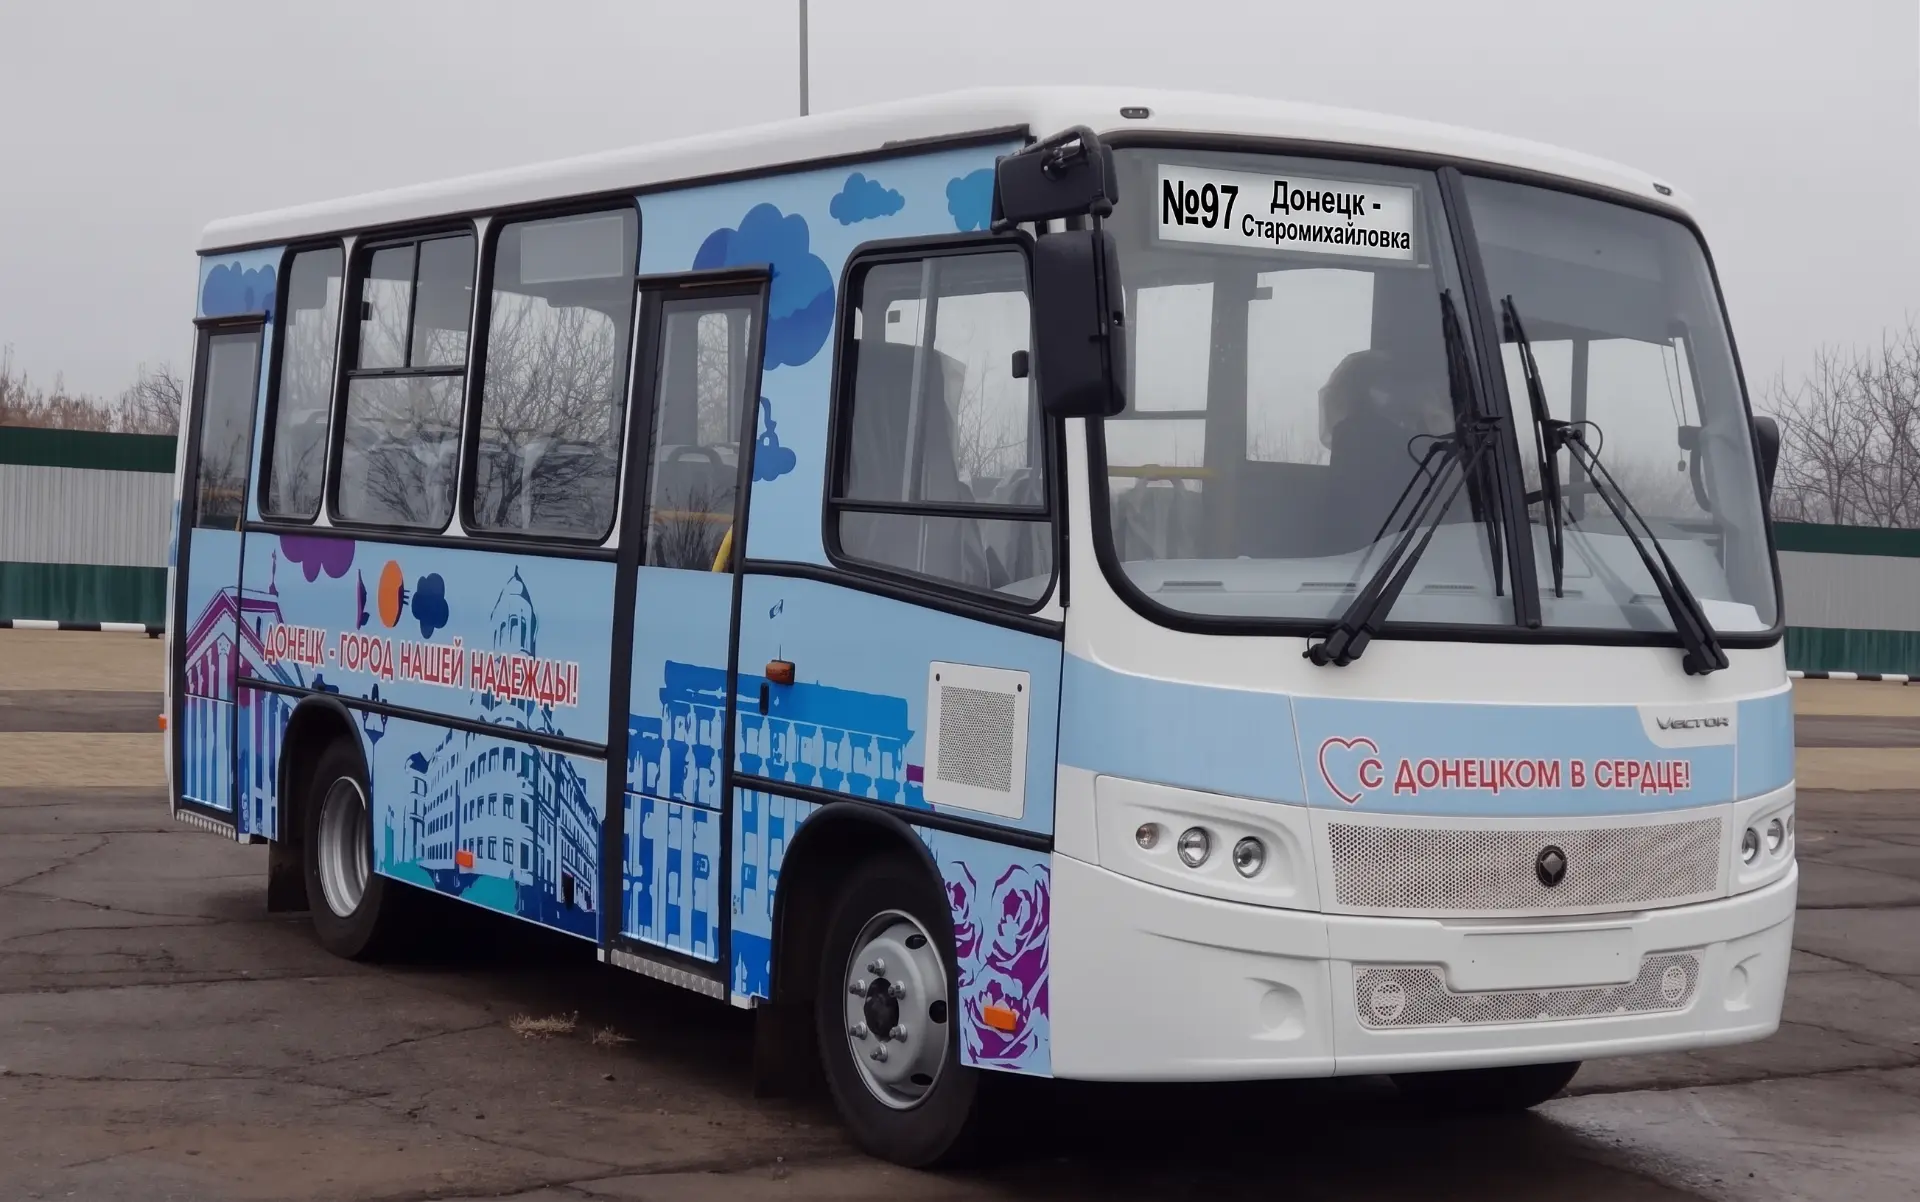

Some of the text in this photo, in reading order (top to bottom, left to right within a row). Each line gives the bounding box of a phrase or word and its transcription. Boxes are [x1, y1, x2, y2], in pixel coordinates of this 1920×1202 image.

[1162, 179, 1239, 230] №97
[1270, 180, 1365, 219] Донецк
[1242, 213, 1411, 250] Старомихайловка
[264, 624, 325, 668] ДОНЕЦК
[339, 634, 393, 681] ГОРОД
[400, 638, 463, 688] НАШЕЙ
[470, 651, 577, 706] НАДЕЖДЫ!
[1359, 759, 1690, 795] С ДОНЕЦКОМ В СЕРДЦЕ!
